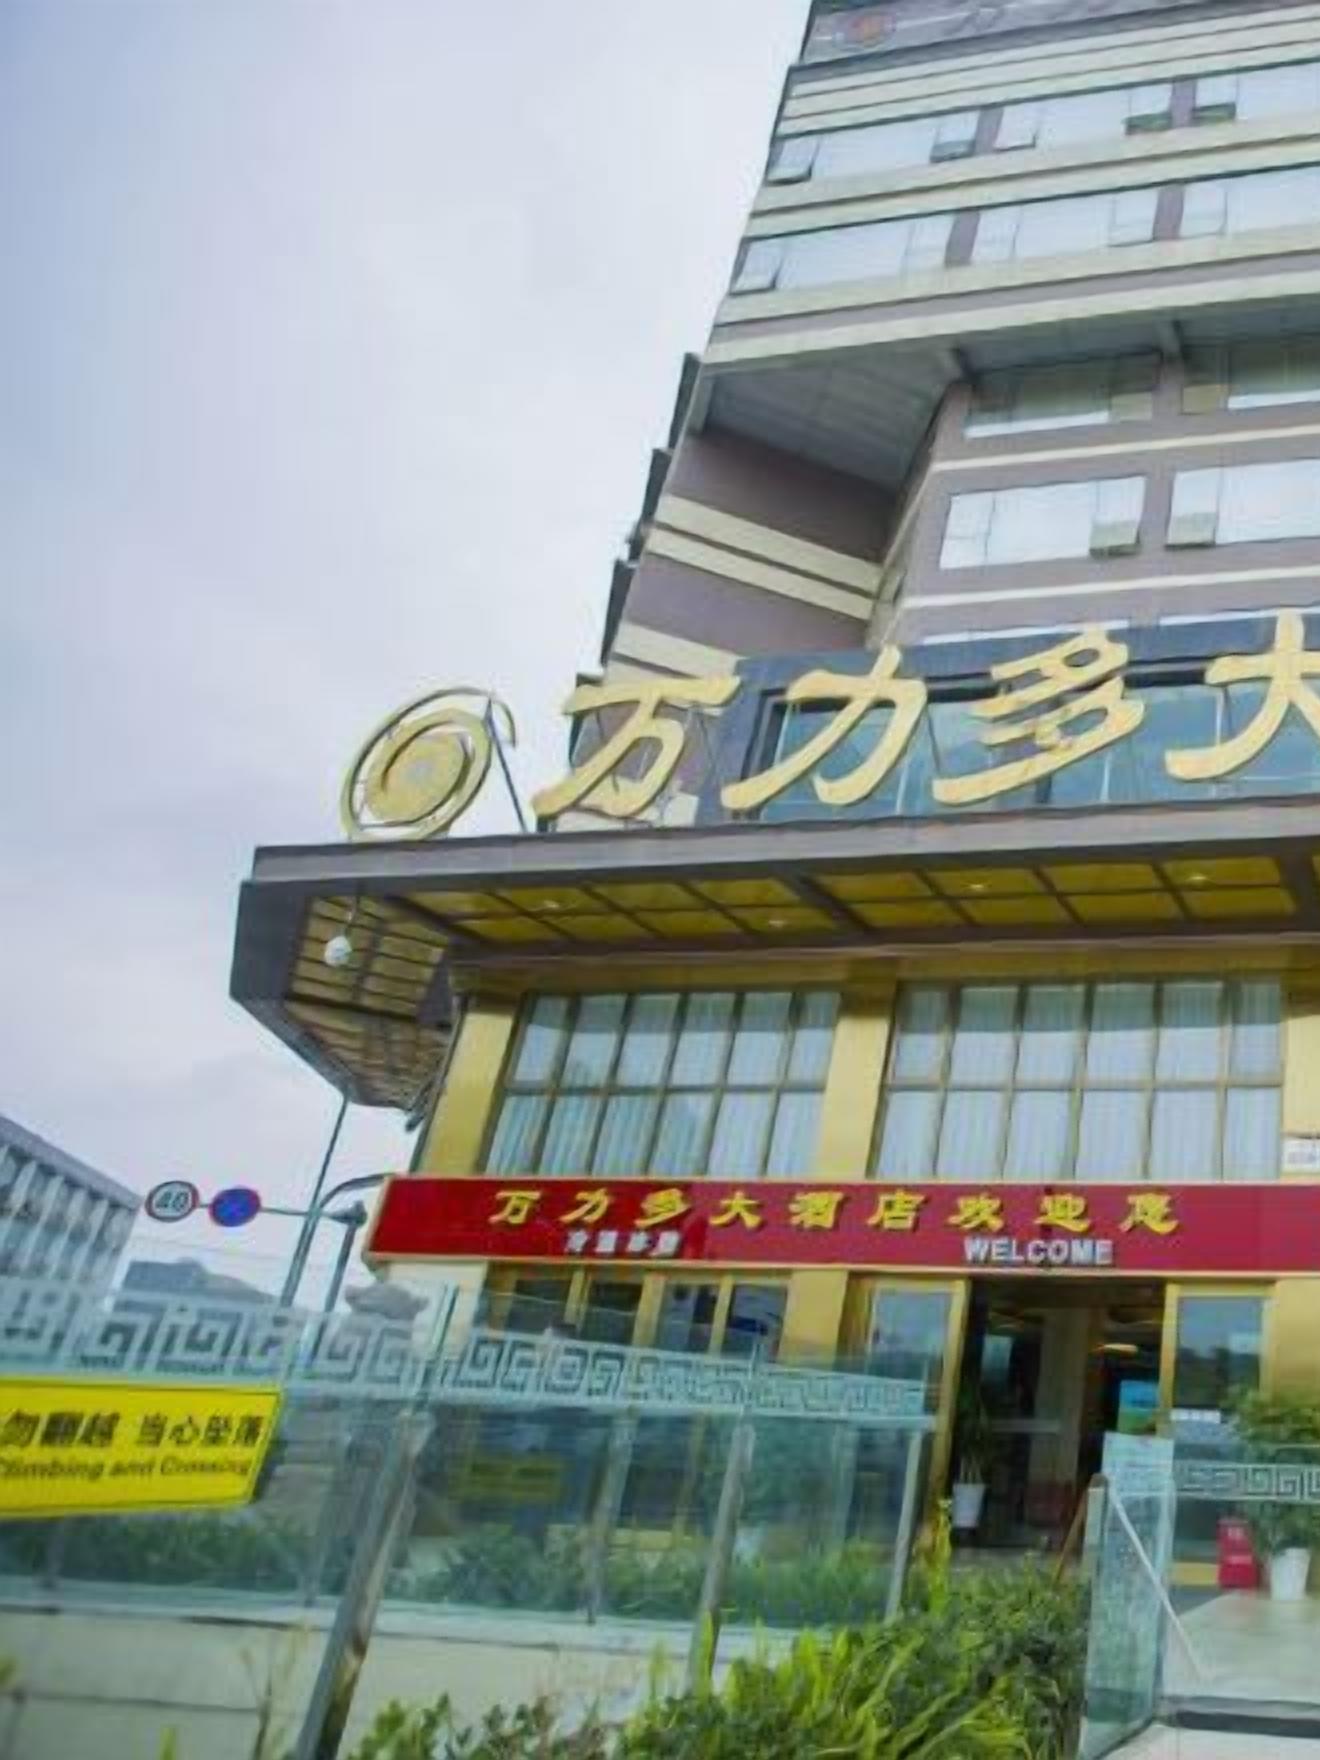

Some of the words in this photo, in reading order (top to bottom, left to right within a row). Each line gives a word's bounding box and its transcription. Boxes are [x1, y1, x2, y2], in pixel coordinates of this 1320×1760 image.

[487, 1187, 1180, 1236] 万力多大酒店欢迎您
[963, 1236, 1114, 1265] WELCOME
[107, 1459, 155, 1478] and
